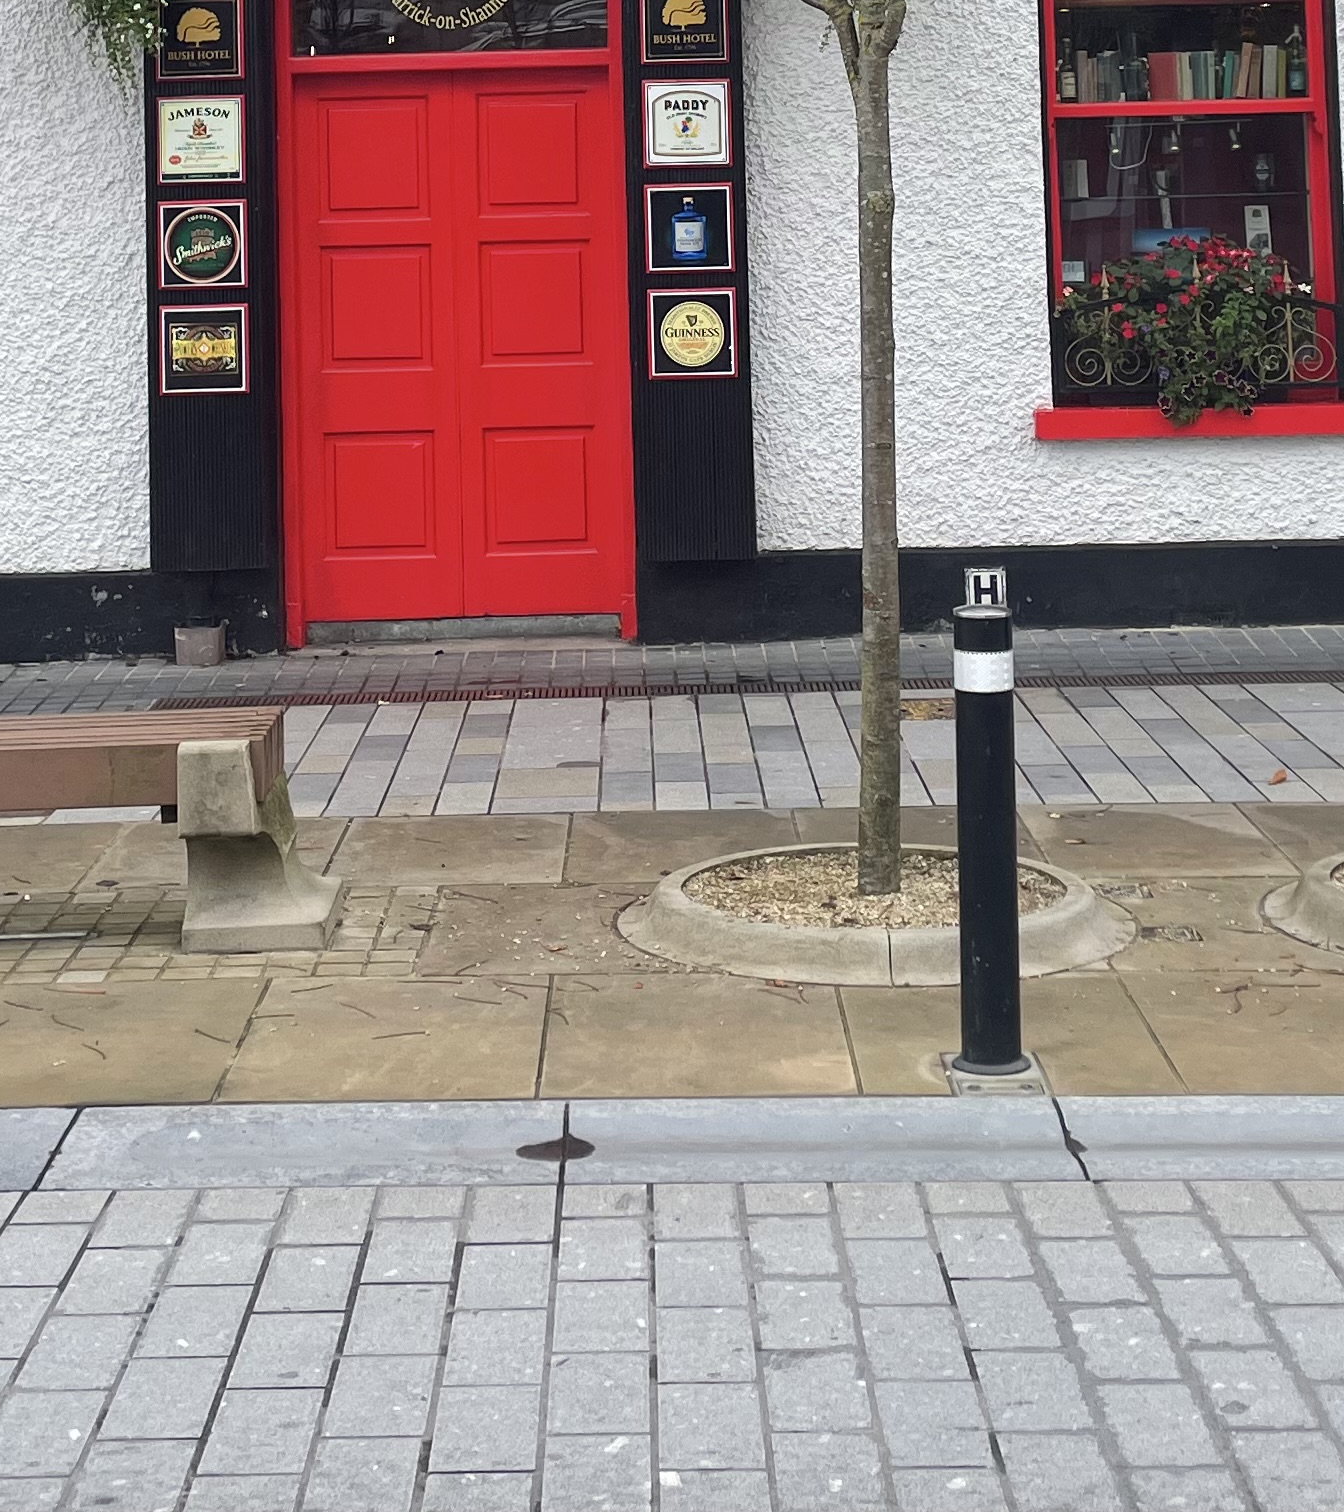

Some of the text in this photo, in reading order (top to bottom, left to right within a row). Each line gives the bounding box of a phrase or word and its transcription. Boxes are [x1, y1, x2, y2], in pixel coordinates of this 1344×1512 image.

[653, 33, 717, 44] BUSH HOTEL
[167, 49, 231, 61] BUSH HOTEL
[664, 99, 709, 111] PADDY
[168, 107, 230, 121] JAMESON
[173, 234, 233, 266] Smithwick's
[664, 327, 720, 338] GUINNESS
[972, 574, 999, 605] H
